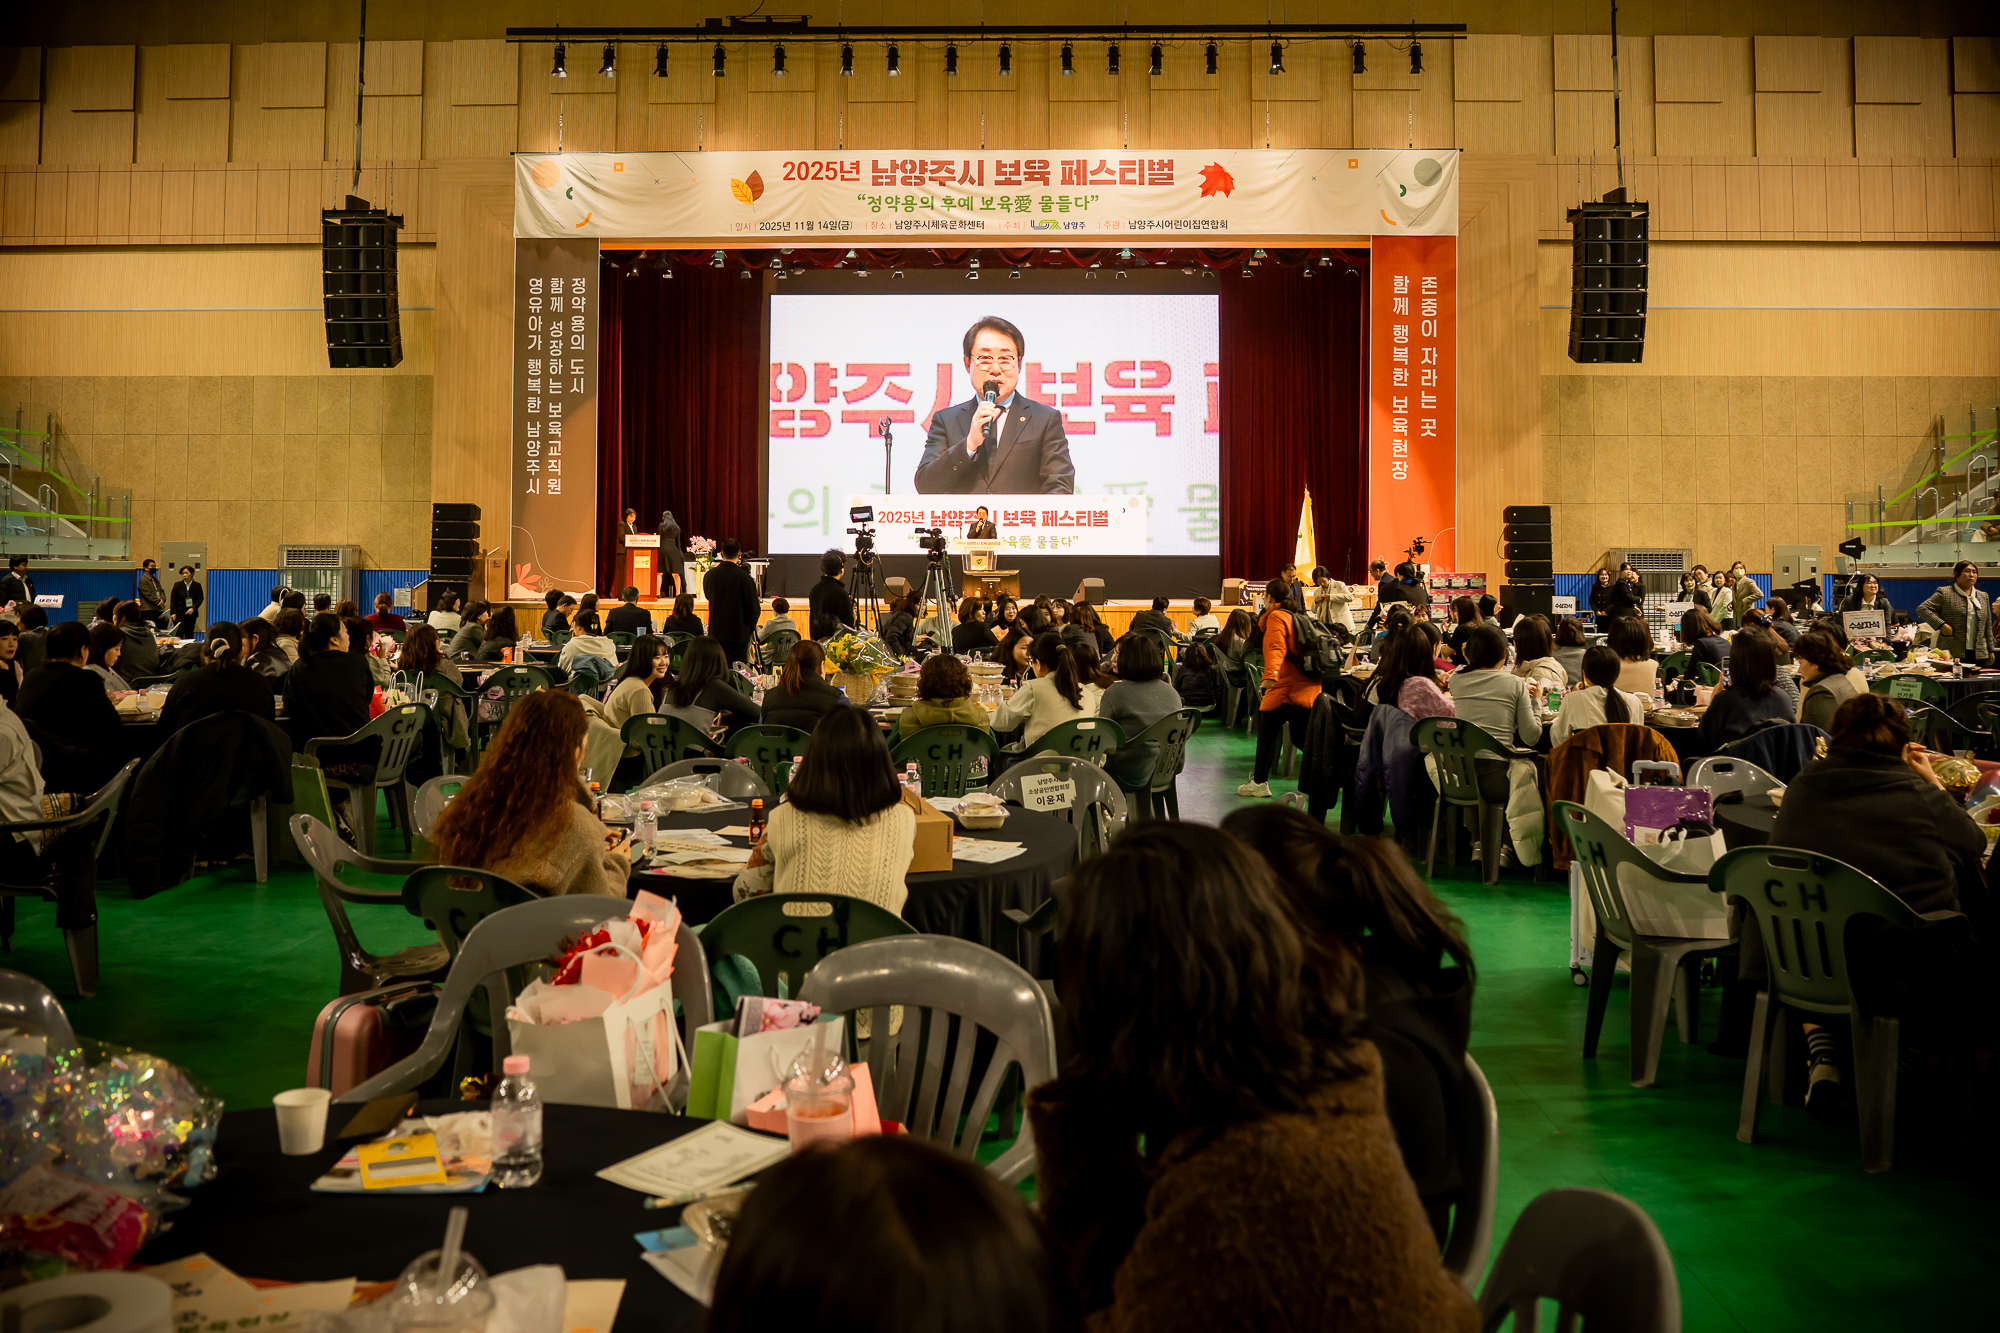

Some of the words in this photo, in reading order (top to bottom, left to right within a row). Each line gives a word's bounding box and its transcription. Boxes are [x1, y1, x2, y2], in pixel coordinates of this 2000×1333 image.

[782, 160, 861, 182] 2025년
[870, 159, 985, 187] 남양주시
[993, 159, 1051, 187] 보육
[1060, 158, 1175, 186] 페스티벌
[735, 222, 751, 231] 일시
[759, 221, 791, 231] 2025년
[794, 220, 814, 231] 11월
[818, 220, 853, 231] 14일(금)
[870, 221, 887, 230] 장소
[894, 220, 985, 230] 남양주시체육문화센터
[1003, 221, 1021, 230] 주최
[1063, 221, 1086, 230] 남양주
[1103, 220, 1120, 230] 주관
[1128, 219, 1228, 230] 남양주시어린이집연합회
[940, 195, 974, 212] 후예
[979, 194, 1032, 214] 보육愛
[527, 277, 543, 351] 영유아가
[550, 277, 565, 313] 함께
[570, 277, 586, 351] 정약용의
[1392, 275, 1410, 316] 함께
[1421, 276, 1438, 338] 존중이
[549, 320, 564, 394] 성장하는
[569, 358, 585, 394] 도시
[1392, 324, 1410, 387] 행복한
[1420, 346, 1438, 409] 자라는
[527, 358, 542, 414] 행복한
[769, 361, 953, 439] 양주
[1025, 360, 1175, 438] 보육
[547, 402, 562, 495] 보육교직원
[1391, 395, 1409, 480] 보육현장
[1420, 418, 1437, 437] 곳
[525, 421, 541, 495] 남양주시
[877, 511, 925, 524] 2025년
[1002, 510, 1036, 527] 보육
[1041, 510, 1109, 527] 페스티벌
[1848, 620, 1880, 630] 수상자석
[1036, 793, 1066, 806] 이윤재
